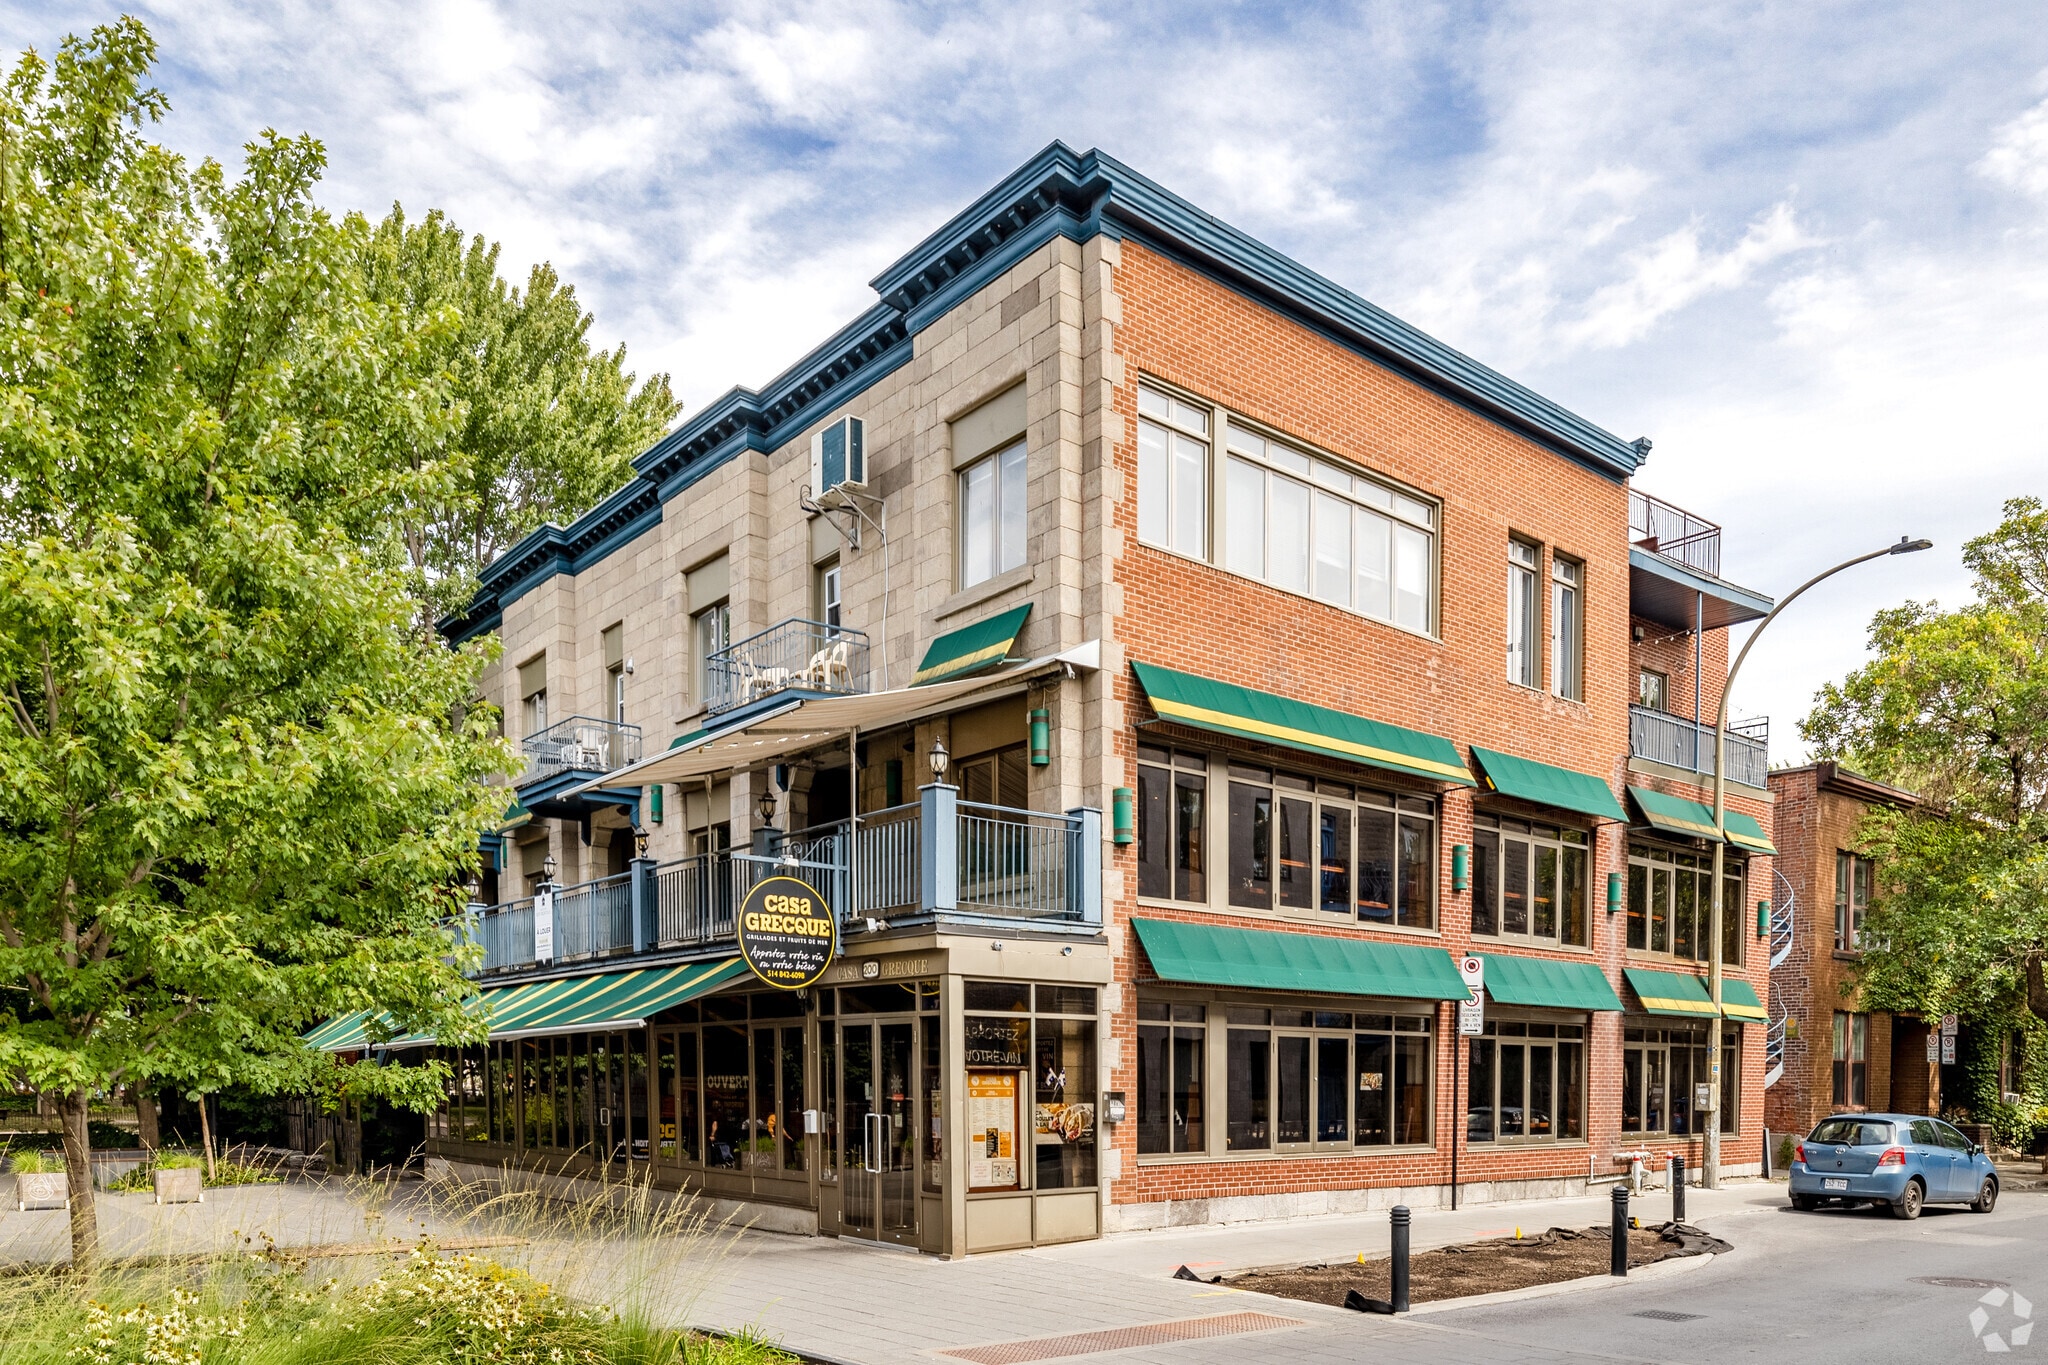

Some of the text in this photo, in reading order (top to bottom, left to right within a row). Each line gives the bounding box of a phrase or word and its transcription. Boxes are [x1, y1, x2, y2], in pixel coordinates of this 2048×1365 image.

[745, 912, 830, 937] GRECQUE
[746, 934, 777, 942] GRILLADES
[750, 945, 825, 962] Apportez votre vin
[772, 959, 793, 970] votre
[795, 960, 816, 971] bière
[836, 959, 928, 980] CASA 200 GRECQUE
[779, 970, 805, 979] 842-6098
[966, 1026, 1019, 1041] APPORTEZ
[1003, 1051, 1022, 1064] VIN
[707, 1075, 749, 1089] OUVERT
